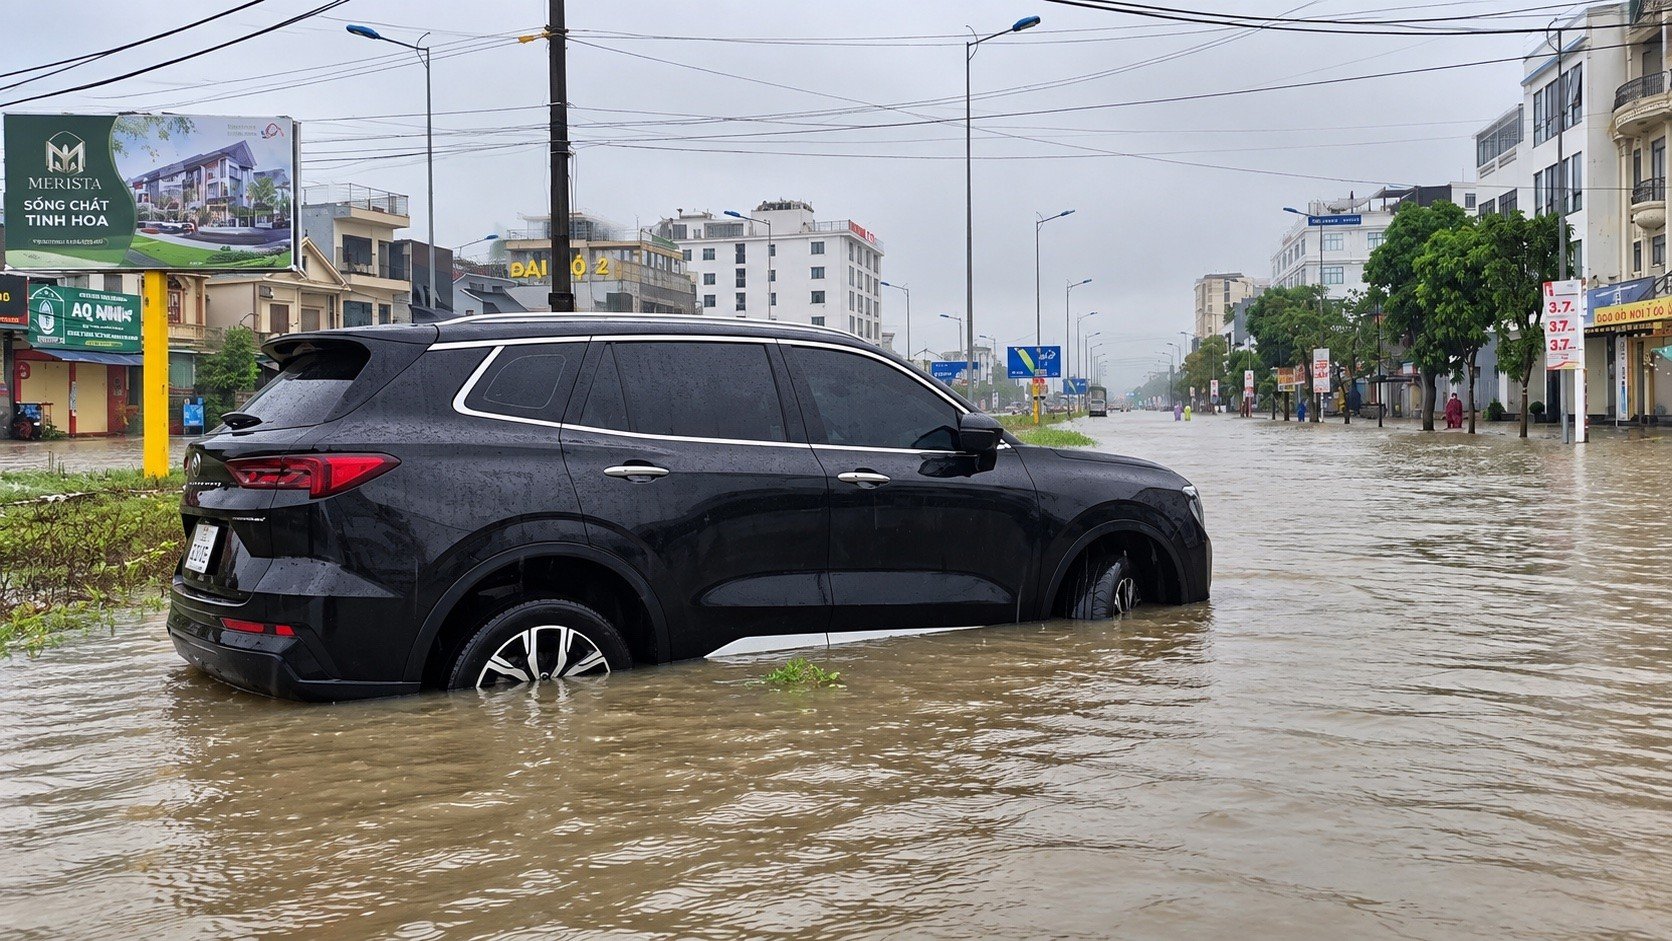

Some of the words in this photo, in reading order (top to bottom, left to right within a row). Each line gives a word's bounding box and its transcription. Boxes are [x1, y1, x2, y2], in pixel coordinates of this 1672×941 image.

[28, 177, 102, 190] MERISTA
[25, 215, 66, 227] TINH
[71, 215, 109, 227] HOA
[595, 256, 610, 275] 2
